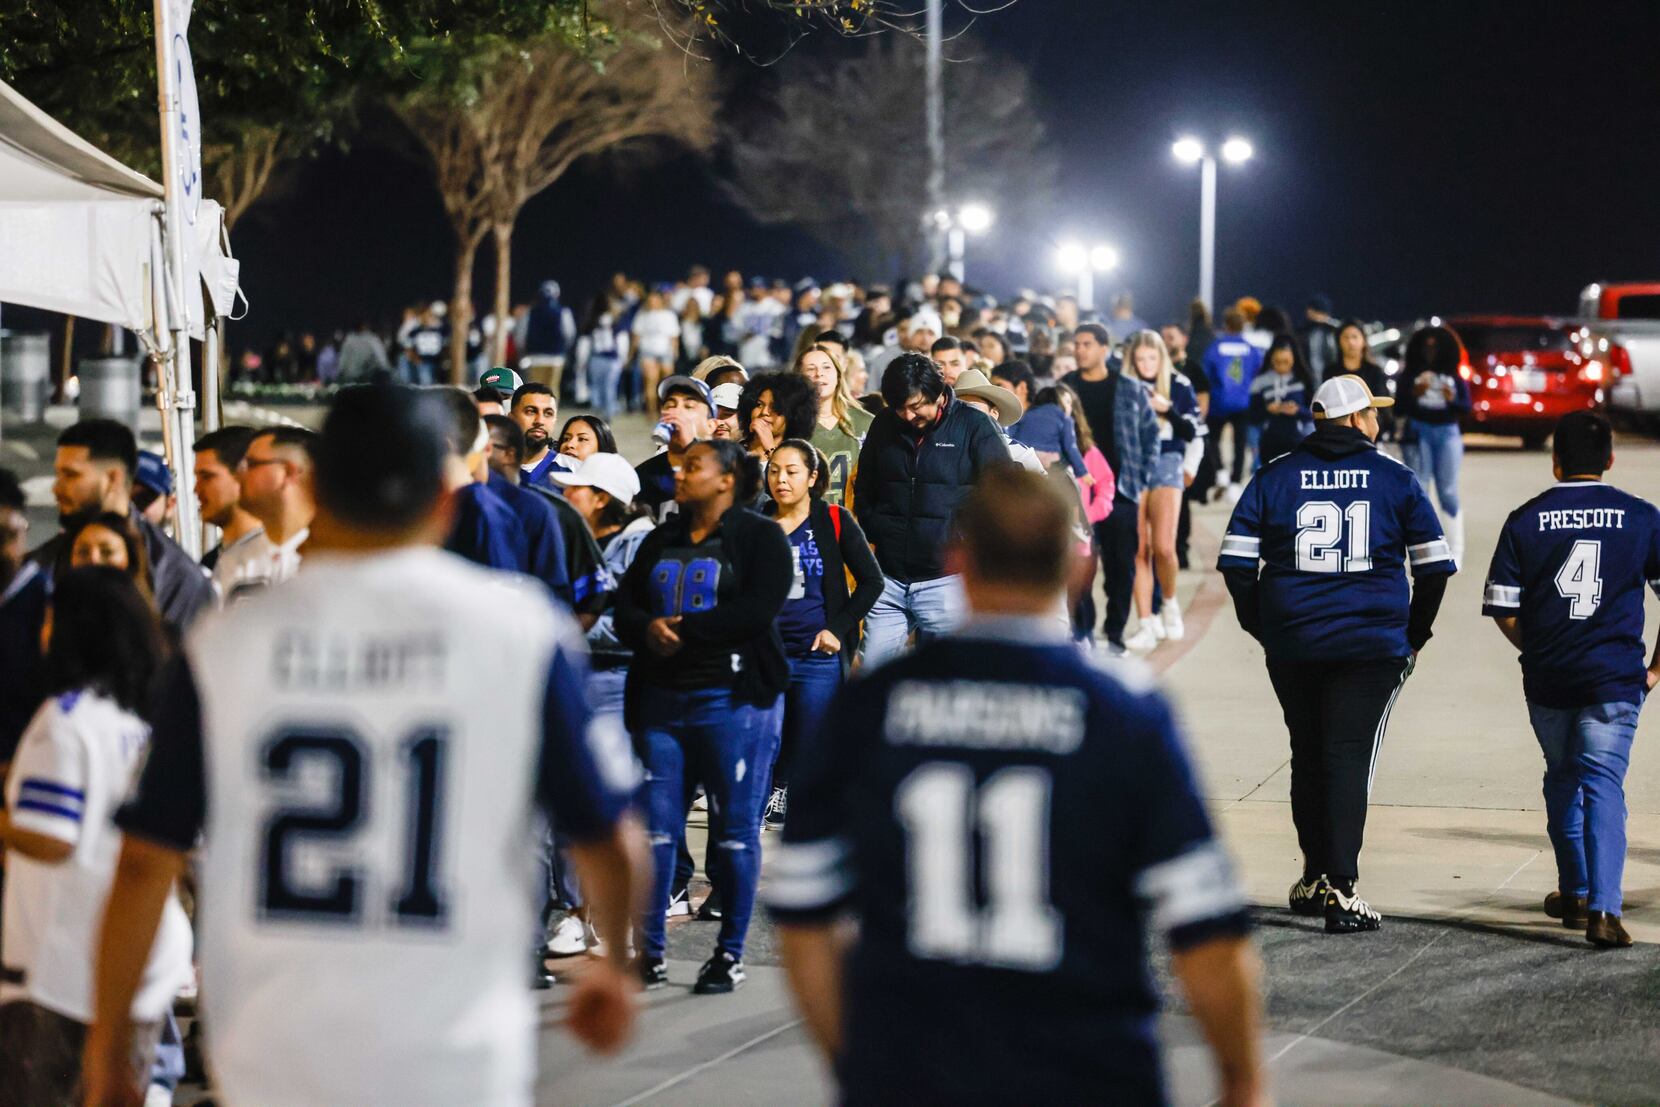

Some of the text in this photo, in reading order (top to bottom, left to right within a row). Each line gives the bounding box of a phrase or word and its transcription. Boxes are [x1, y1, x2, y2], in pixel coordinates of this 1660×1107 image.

[1300, 469, 1370, 490] ELLIOTT
[1294, 500, 1373, 573] 21
[1538, 508, 1625, 532] PRESCOTT
[1554, 539, 1603, 620] 4
[258, 727, 453, 934] 21
[895, 761, 1064, 973] 11
